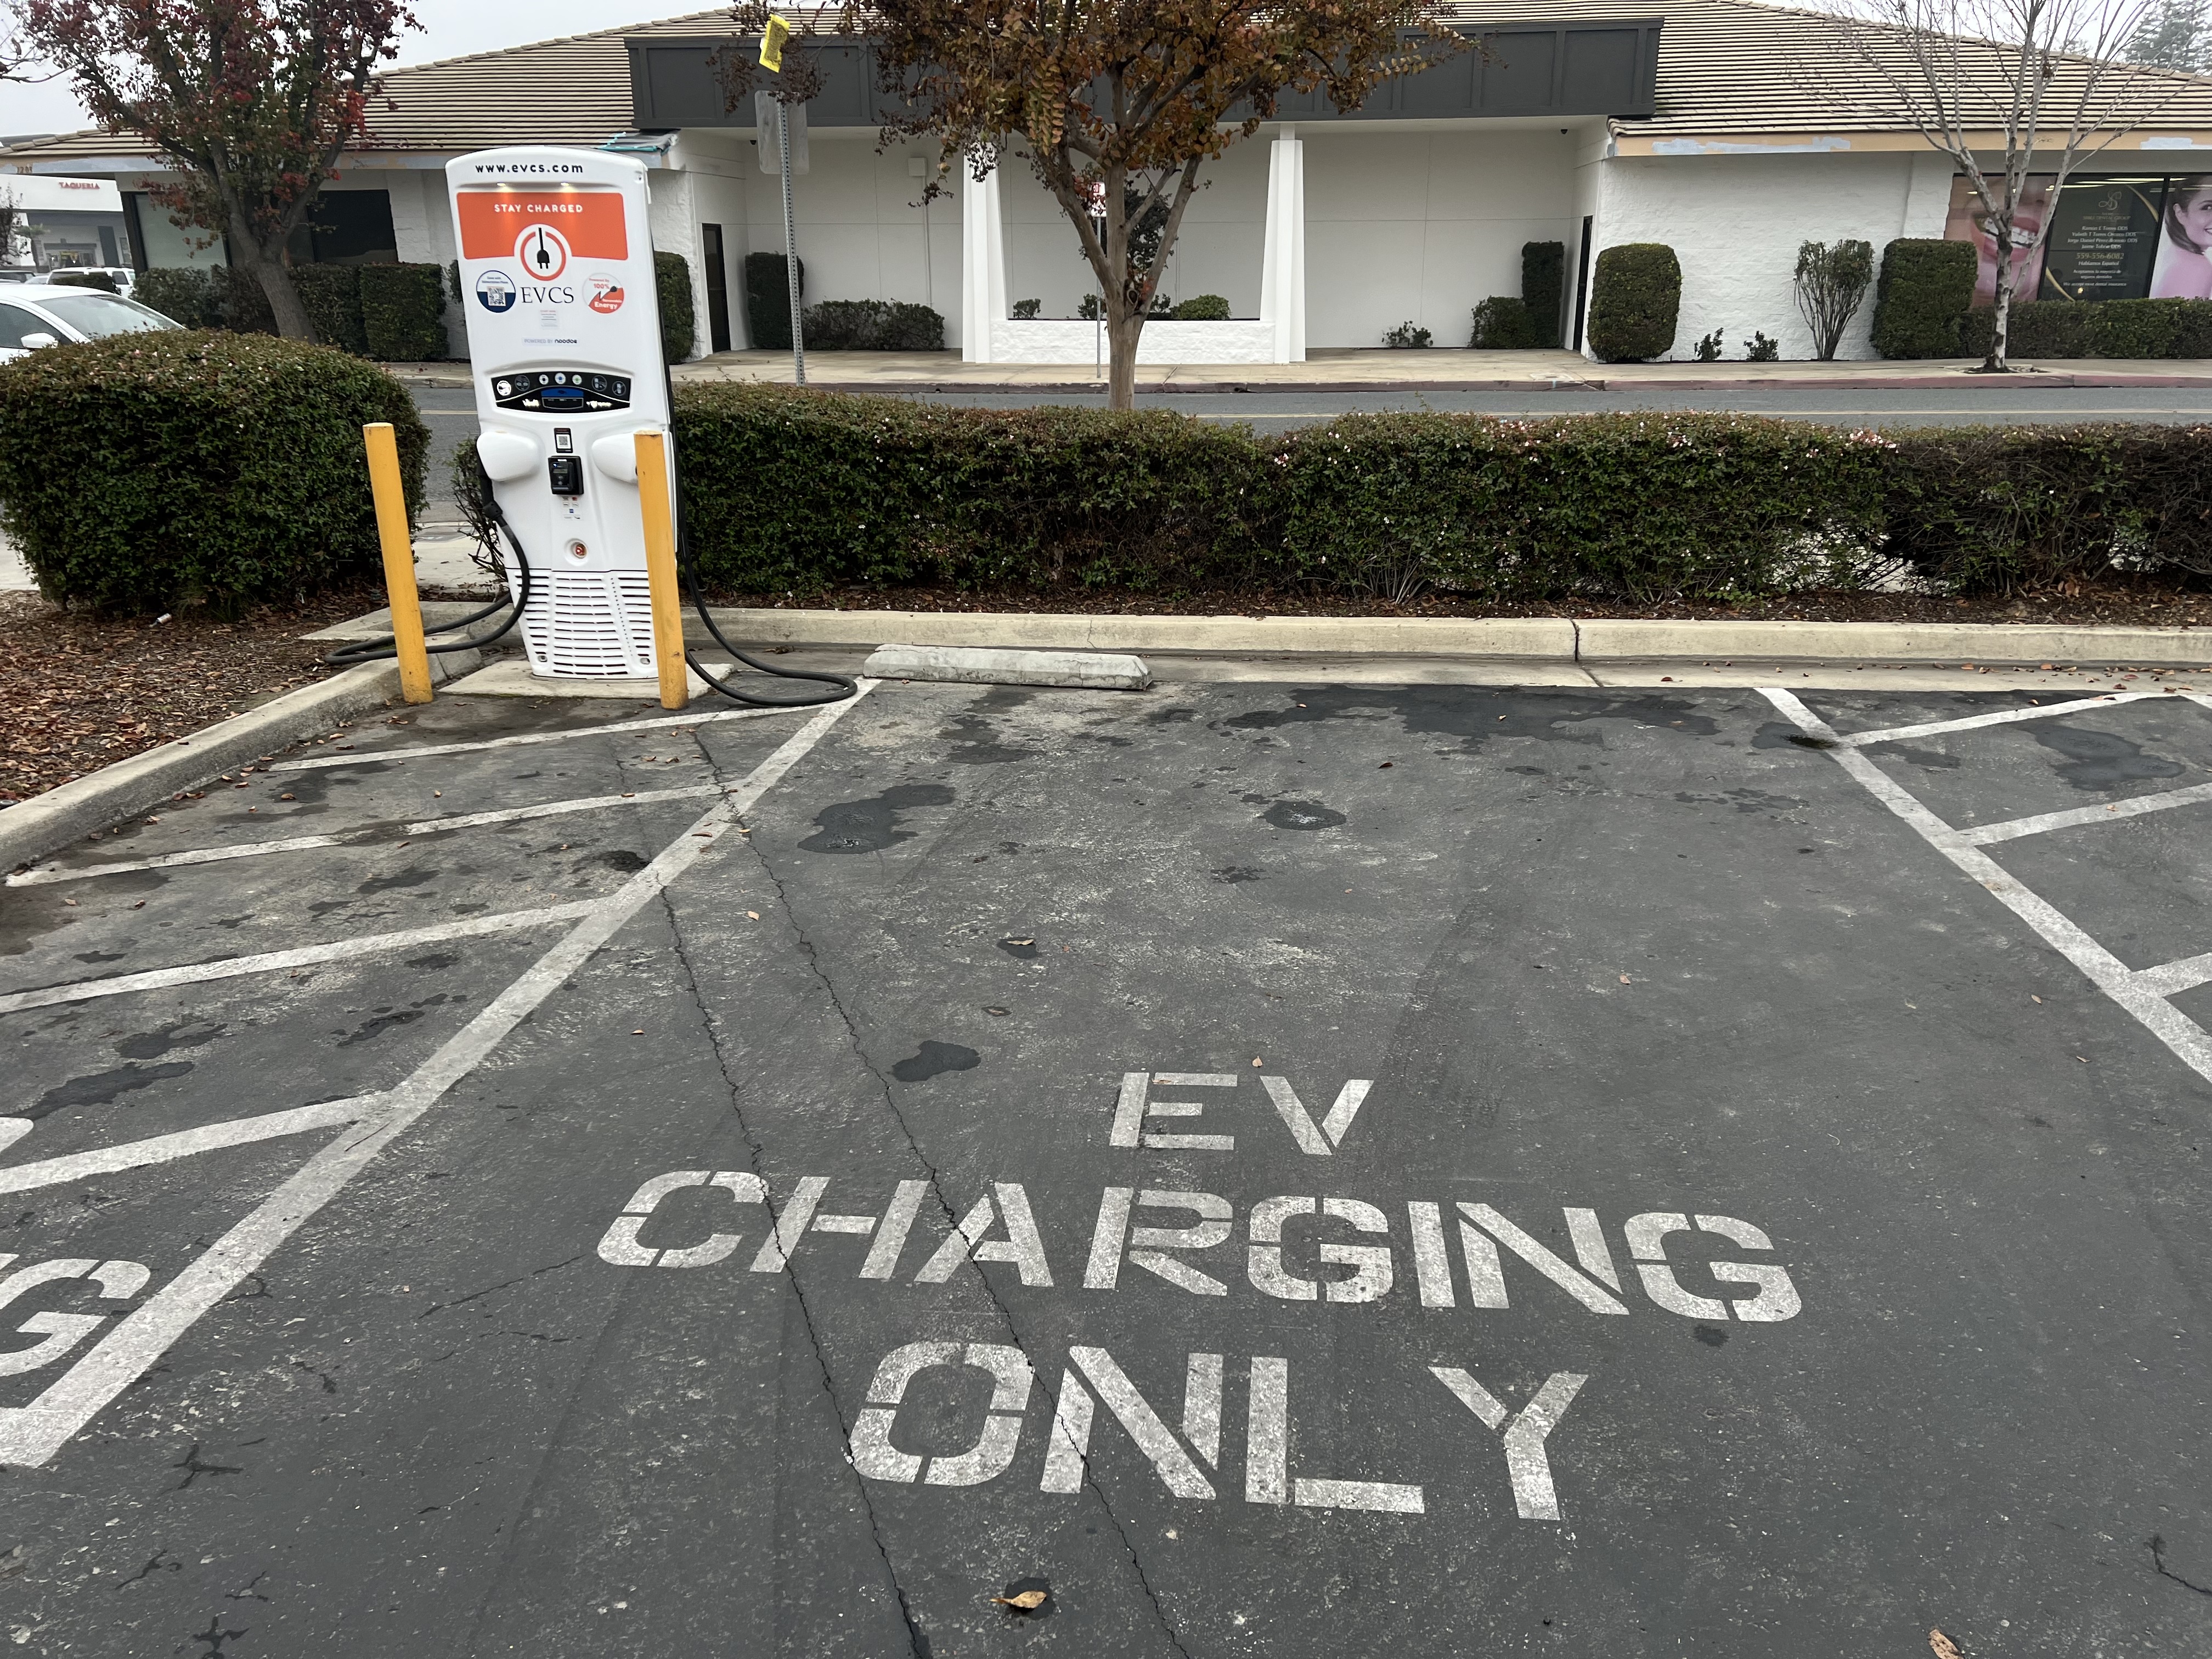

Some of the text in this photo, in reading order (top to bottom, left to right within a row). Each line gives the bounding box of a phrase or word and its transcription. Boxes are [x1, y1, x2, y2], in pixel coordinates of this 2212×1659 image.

[475, 165, 583, 173] www.evcs.com
[494, 204, 583, 213] STAY CHARGED
[520, 287, 574, 303] EVCS
[594, 301, 618, 309] Energy
[1110, 1073, 1374, 1155] EV
[597, 1171, 1802, 1322] CHARGING
[0, 1253, 150, 1375] G
[850, 1342, 1589, 1521] ONLY
